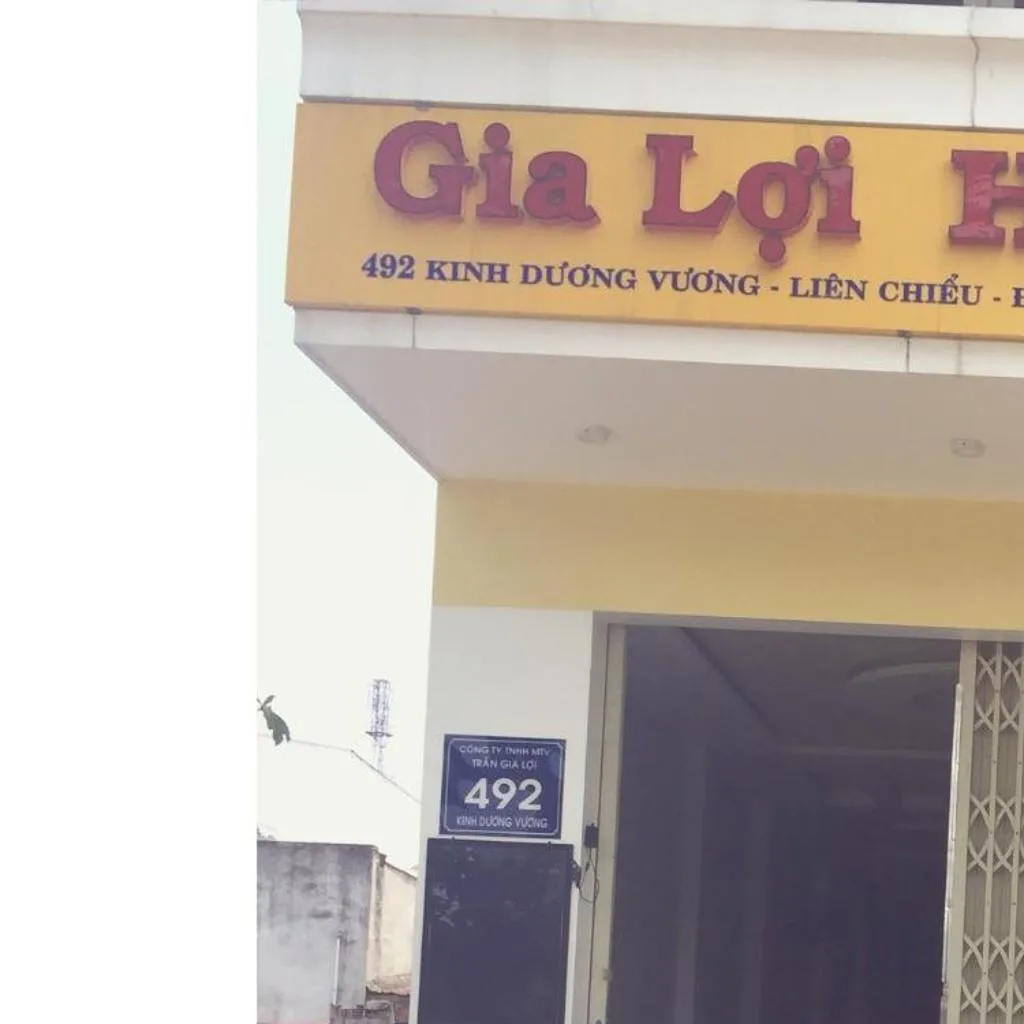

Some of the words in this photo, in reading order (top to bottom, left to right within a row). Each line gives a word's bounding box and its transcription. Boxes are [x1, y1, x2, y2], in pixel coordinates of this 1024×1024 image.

[373, 119, 600, 224] Gia
[642, 133, 861, 265] Lợi
[361, 253, 415, 279] 492
[426, 260, 509, 283] KINH
[520, 261, 637, 290] DƯƠNG
[647, 267, 760, 296] VƯƠNG
[789, 273, 868, 300] LIÊN
[878, 273, 983, 306] CHIỂU
[500, 759, 519, 769] GIA
[463, 777, 542, 811] 492
